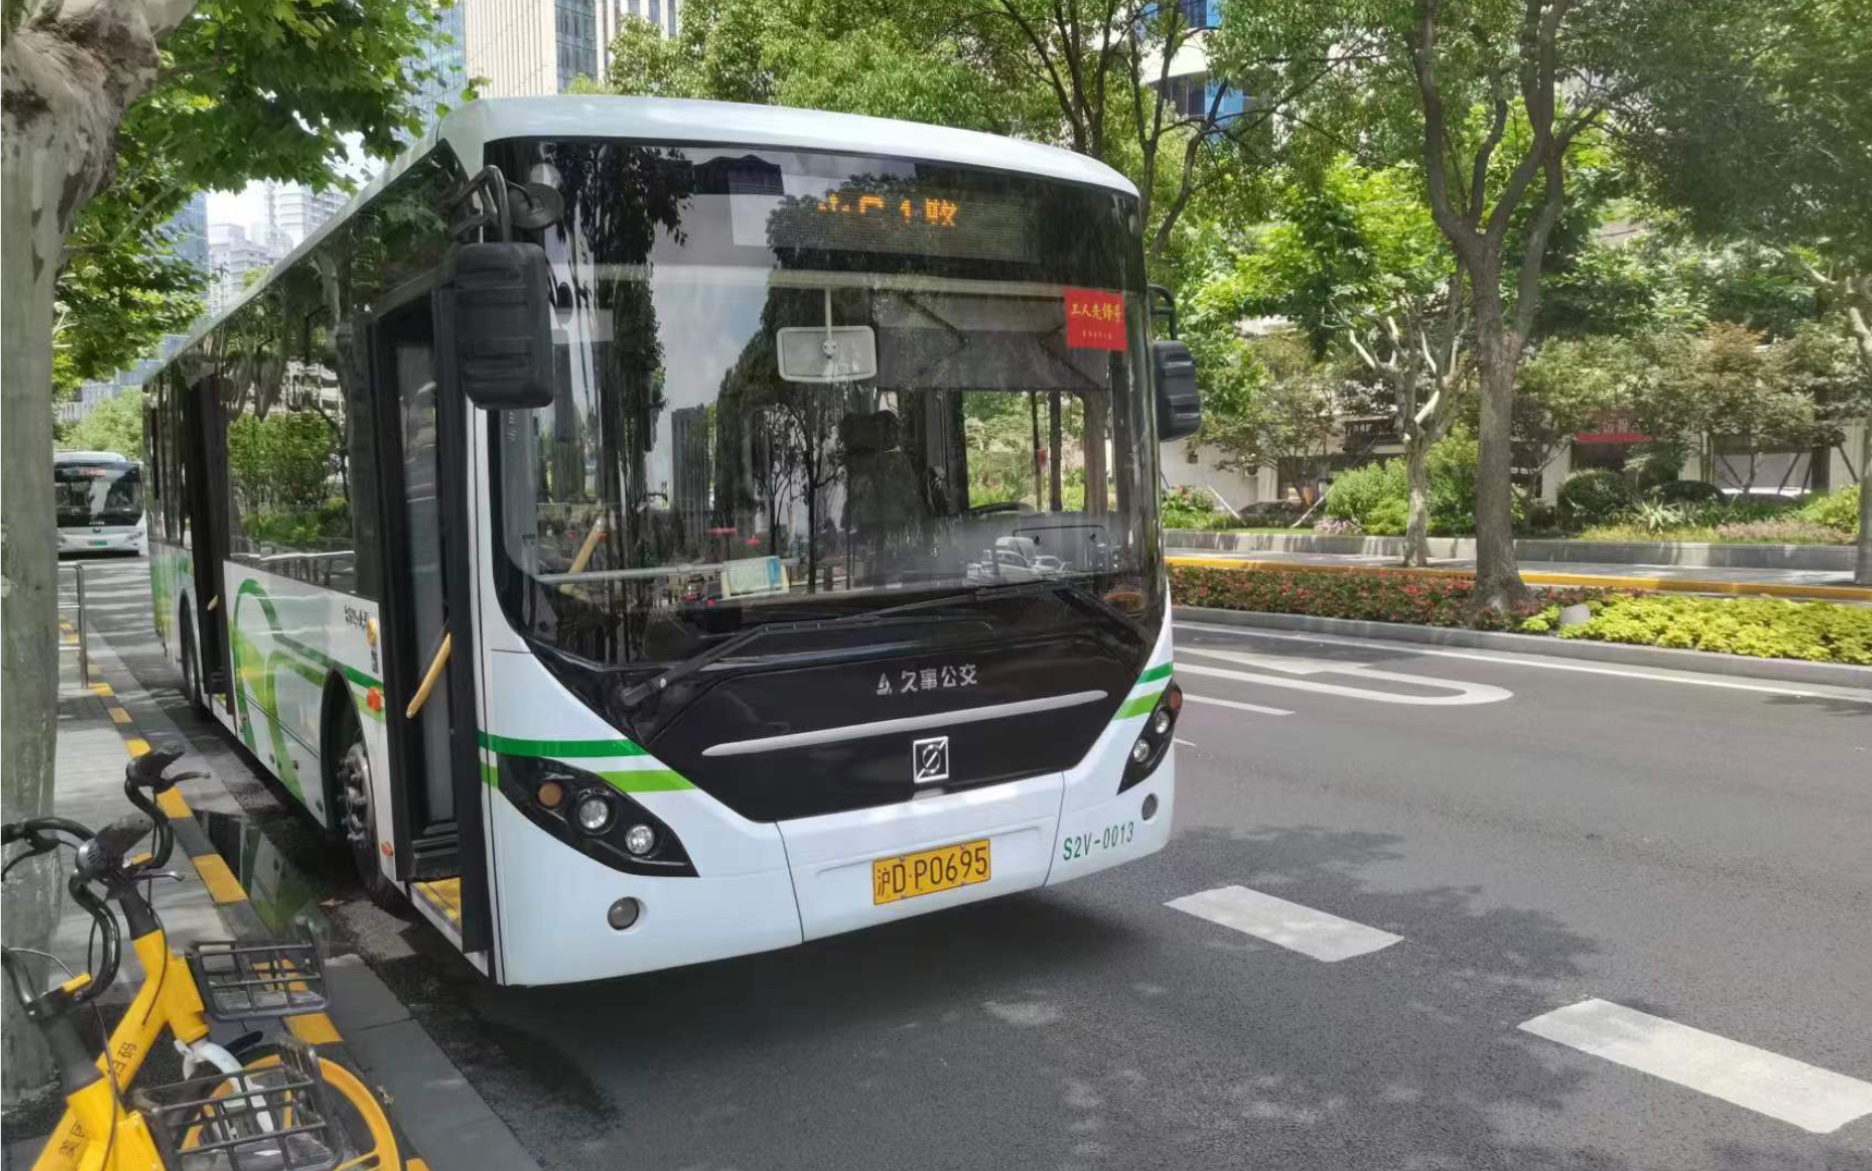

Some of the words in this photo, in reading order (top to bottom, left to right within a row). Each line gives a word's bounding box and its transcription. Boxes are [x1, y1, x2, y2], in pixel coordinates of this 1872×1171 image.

[1071, 302, 1122, 323] 工人先锋号
[901, 664, 978, 694] 久事公交
[1063, 821, 1134, 861] S2V-0013
